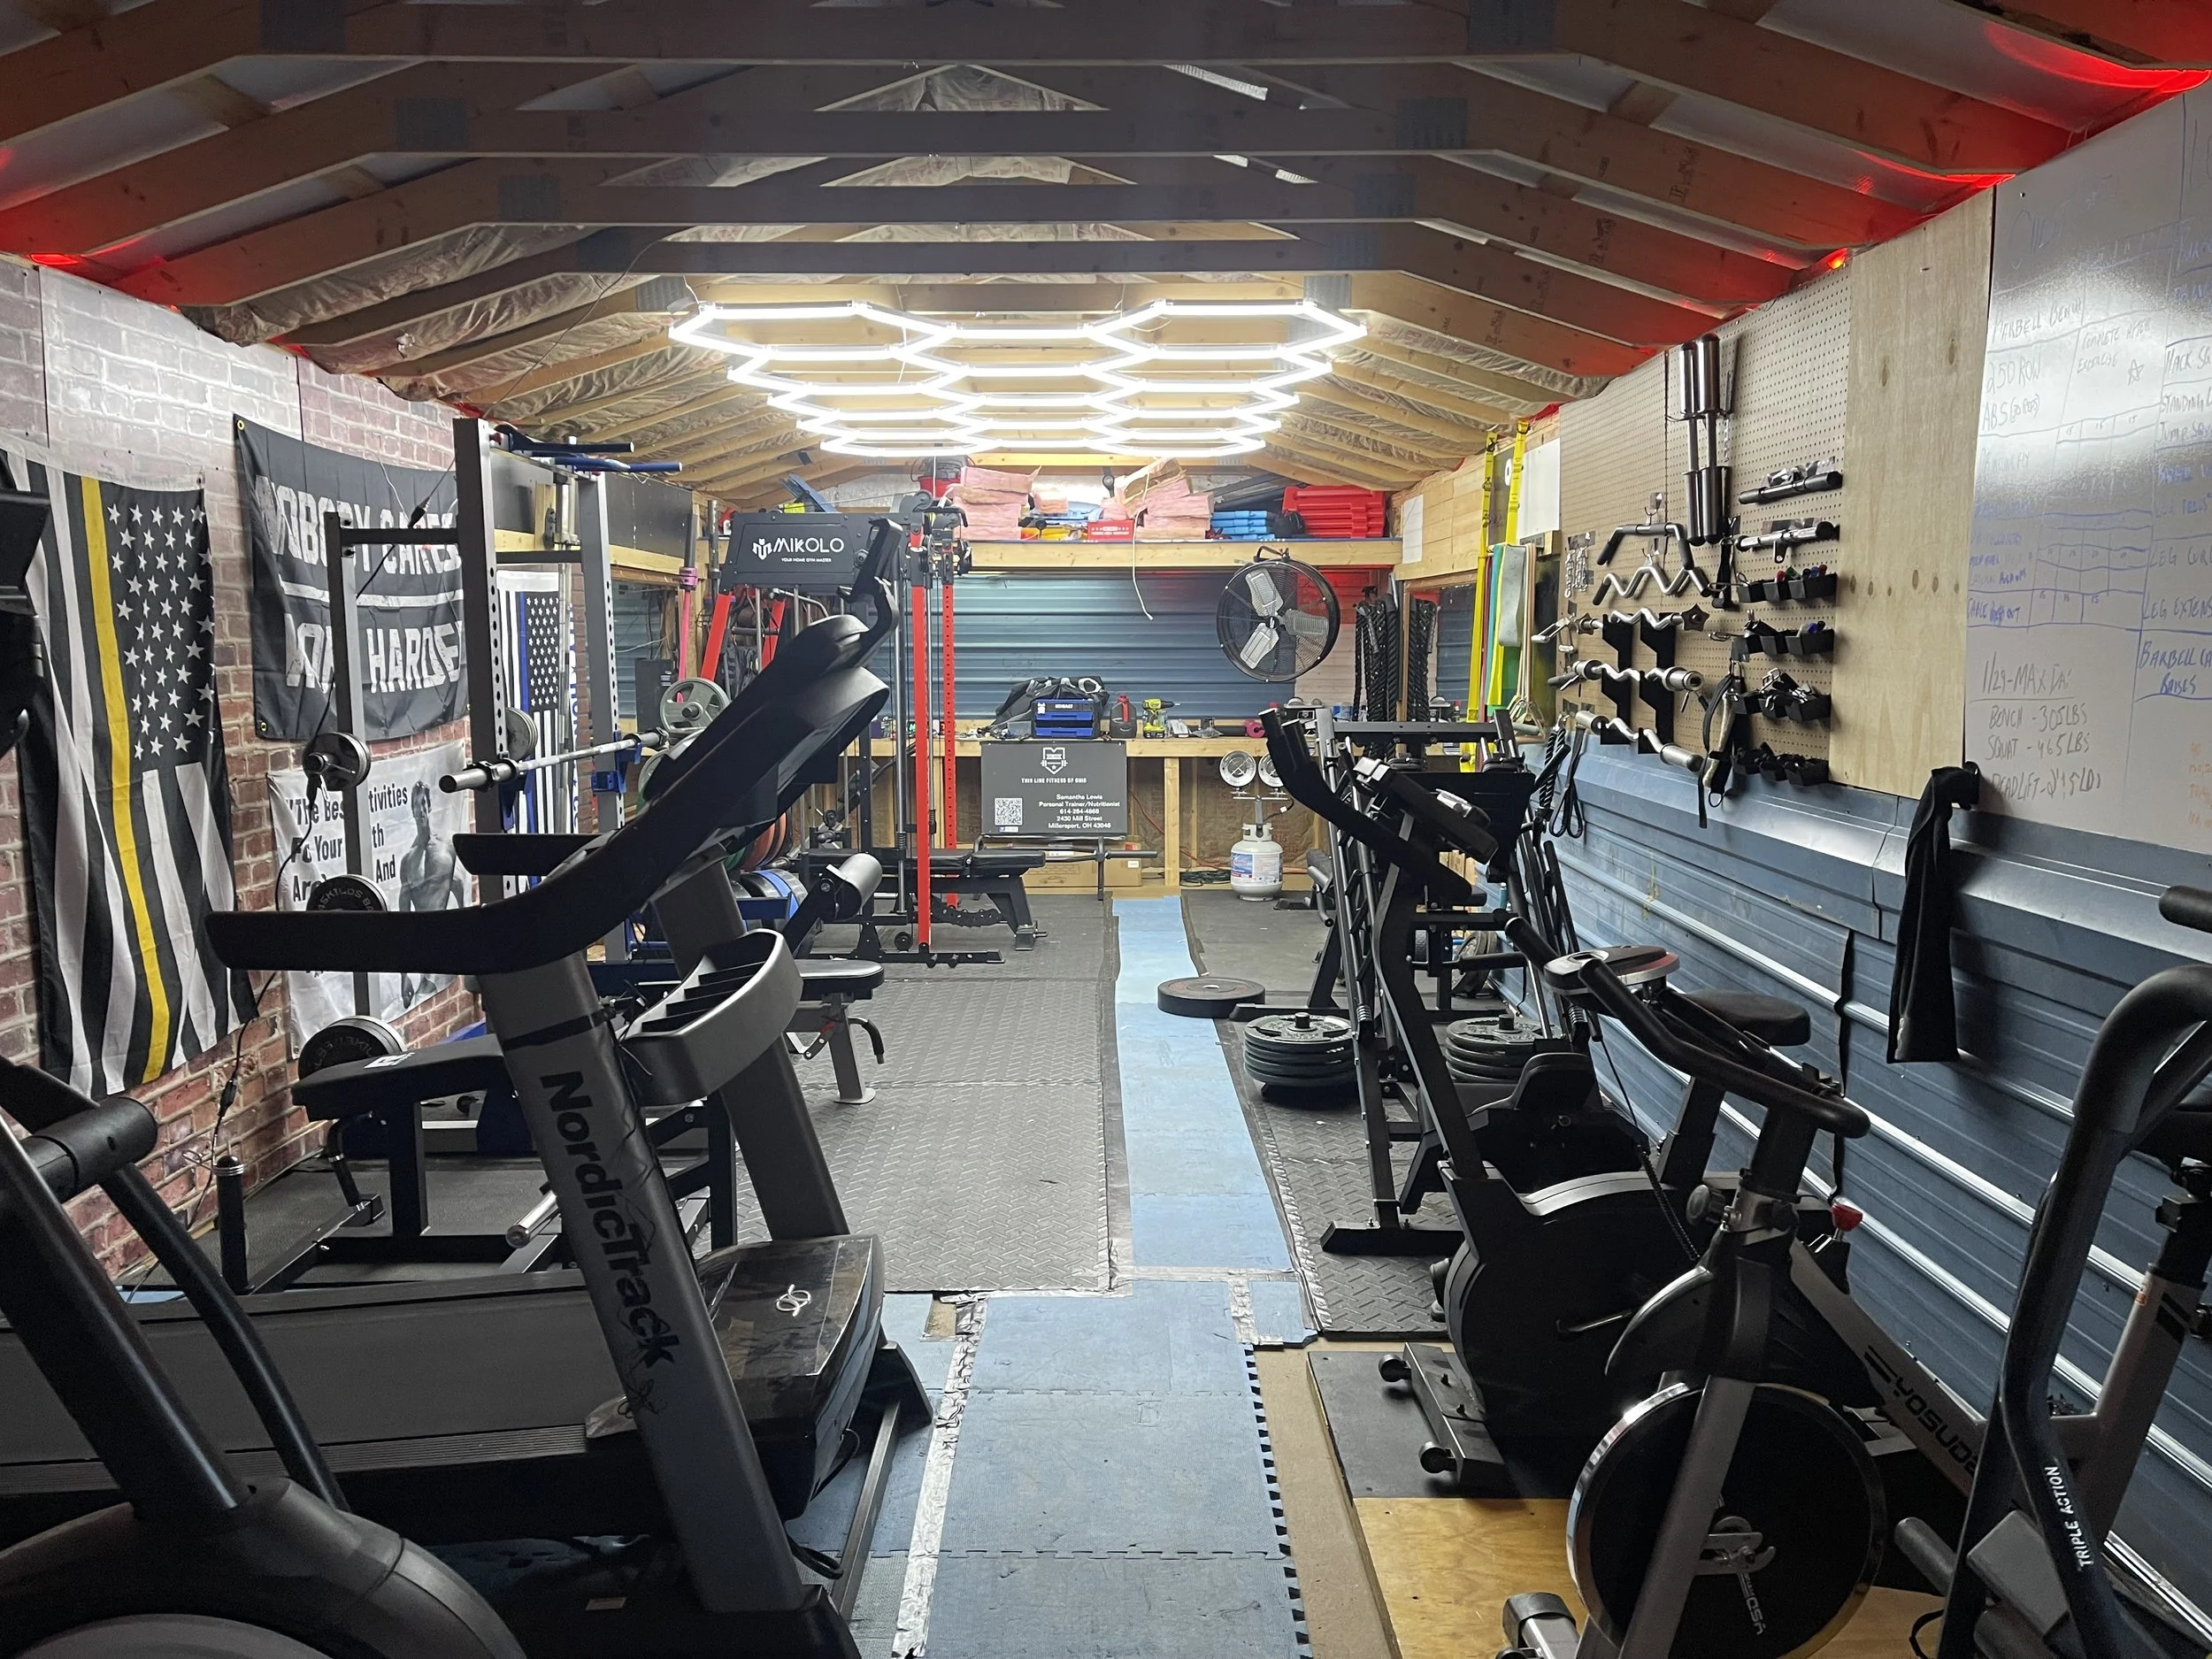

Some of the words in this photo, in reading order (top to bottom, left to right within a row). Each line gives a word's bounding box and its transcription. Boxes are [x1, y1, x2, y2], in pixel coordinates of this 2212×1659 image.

[772, 538, 845, 553] MIKOLO
[366, 620, 463, 693] HARDE
[1989, 705, 2023, 729] BENCH
[1985, 735, 2019, 760] SQUAT
[324, 800, 344, 821] Bes
[368, 786, 408, 813] tivities
[314, 835, 342, 862] Your
[376, 854, 396, 883] And
[540, 1071, 680, 1368] NordicTrack
[2044, 1465, 2074, 1515] ACTION
[2064, 1520, 2094, 1572] TRIPLE
